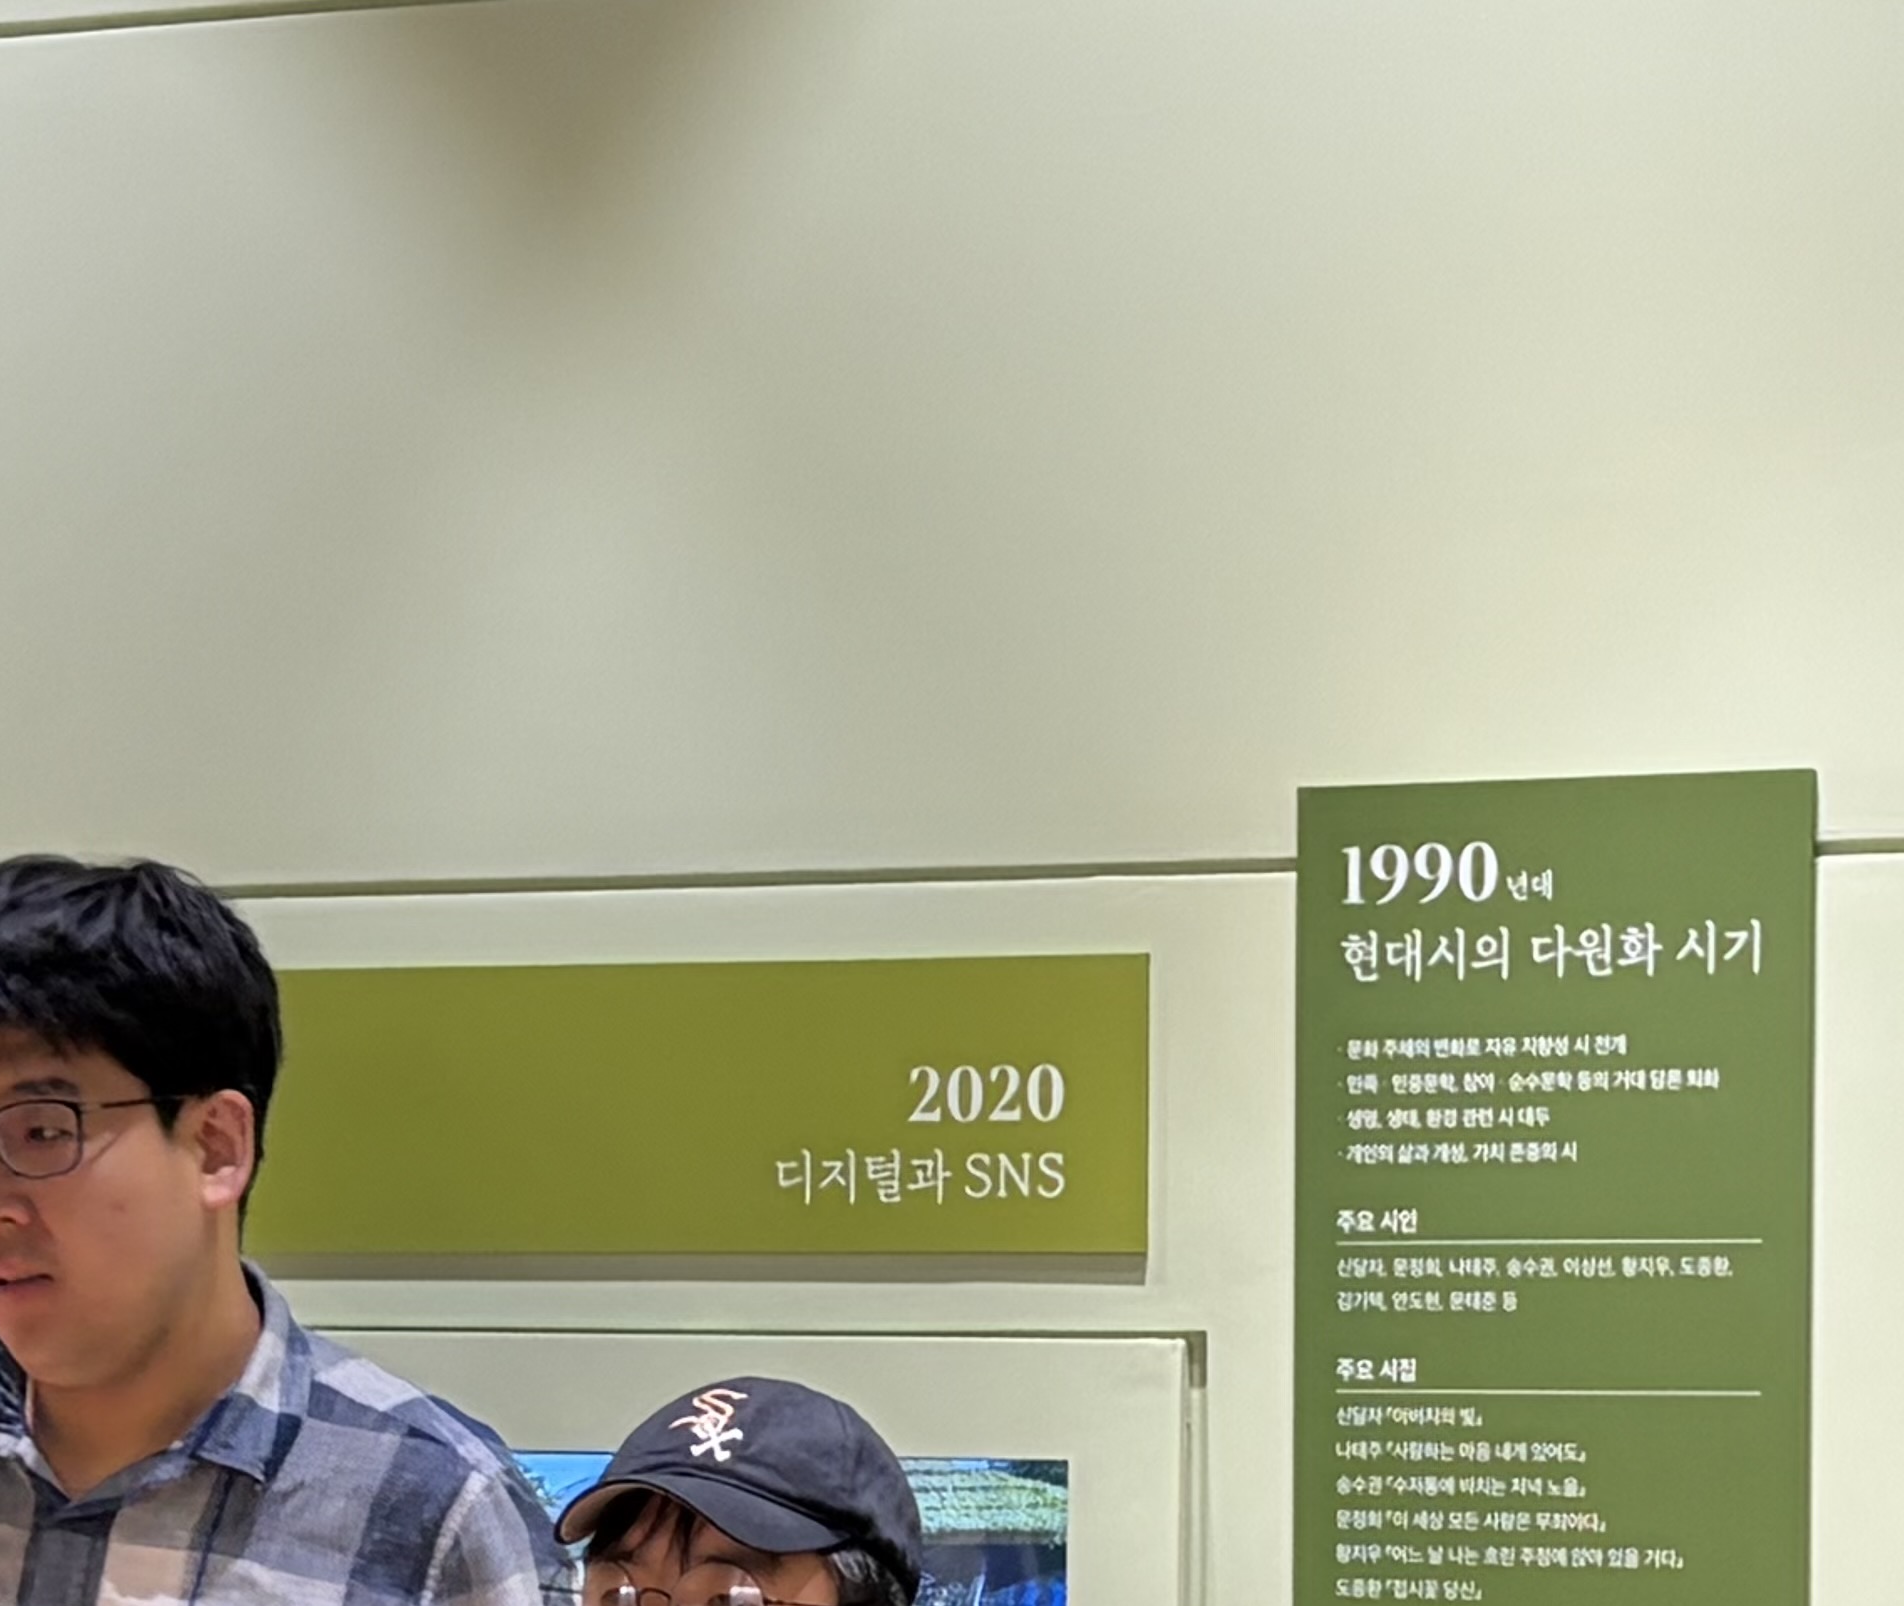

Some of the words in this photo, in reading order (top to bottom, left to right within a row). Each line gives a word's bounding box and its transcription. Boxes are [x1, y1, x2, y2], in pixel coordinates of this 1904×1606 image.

[1342, 840, 1499, 905] 1990
[1506, 868, 1553, 901] 년대
[1340, 925, 1509, 982] 현대시의
[1530, 921, 1663, 978] 다원화
[1676, 918, 1761, 975] 시기
[908, 1063, 1065, 1123] 2020
[776, 1148, 952, 1205] 디지털과
[964, 1151, 1065, 1199] SNS
[1336, 1209, 1375, 1234] 주요
[1379, 1208, 1418, 1234] 시인
[1336, 1357, 1374, 1381] 주요
[1379, 1357, 1416, 1383] 시집
